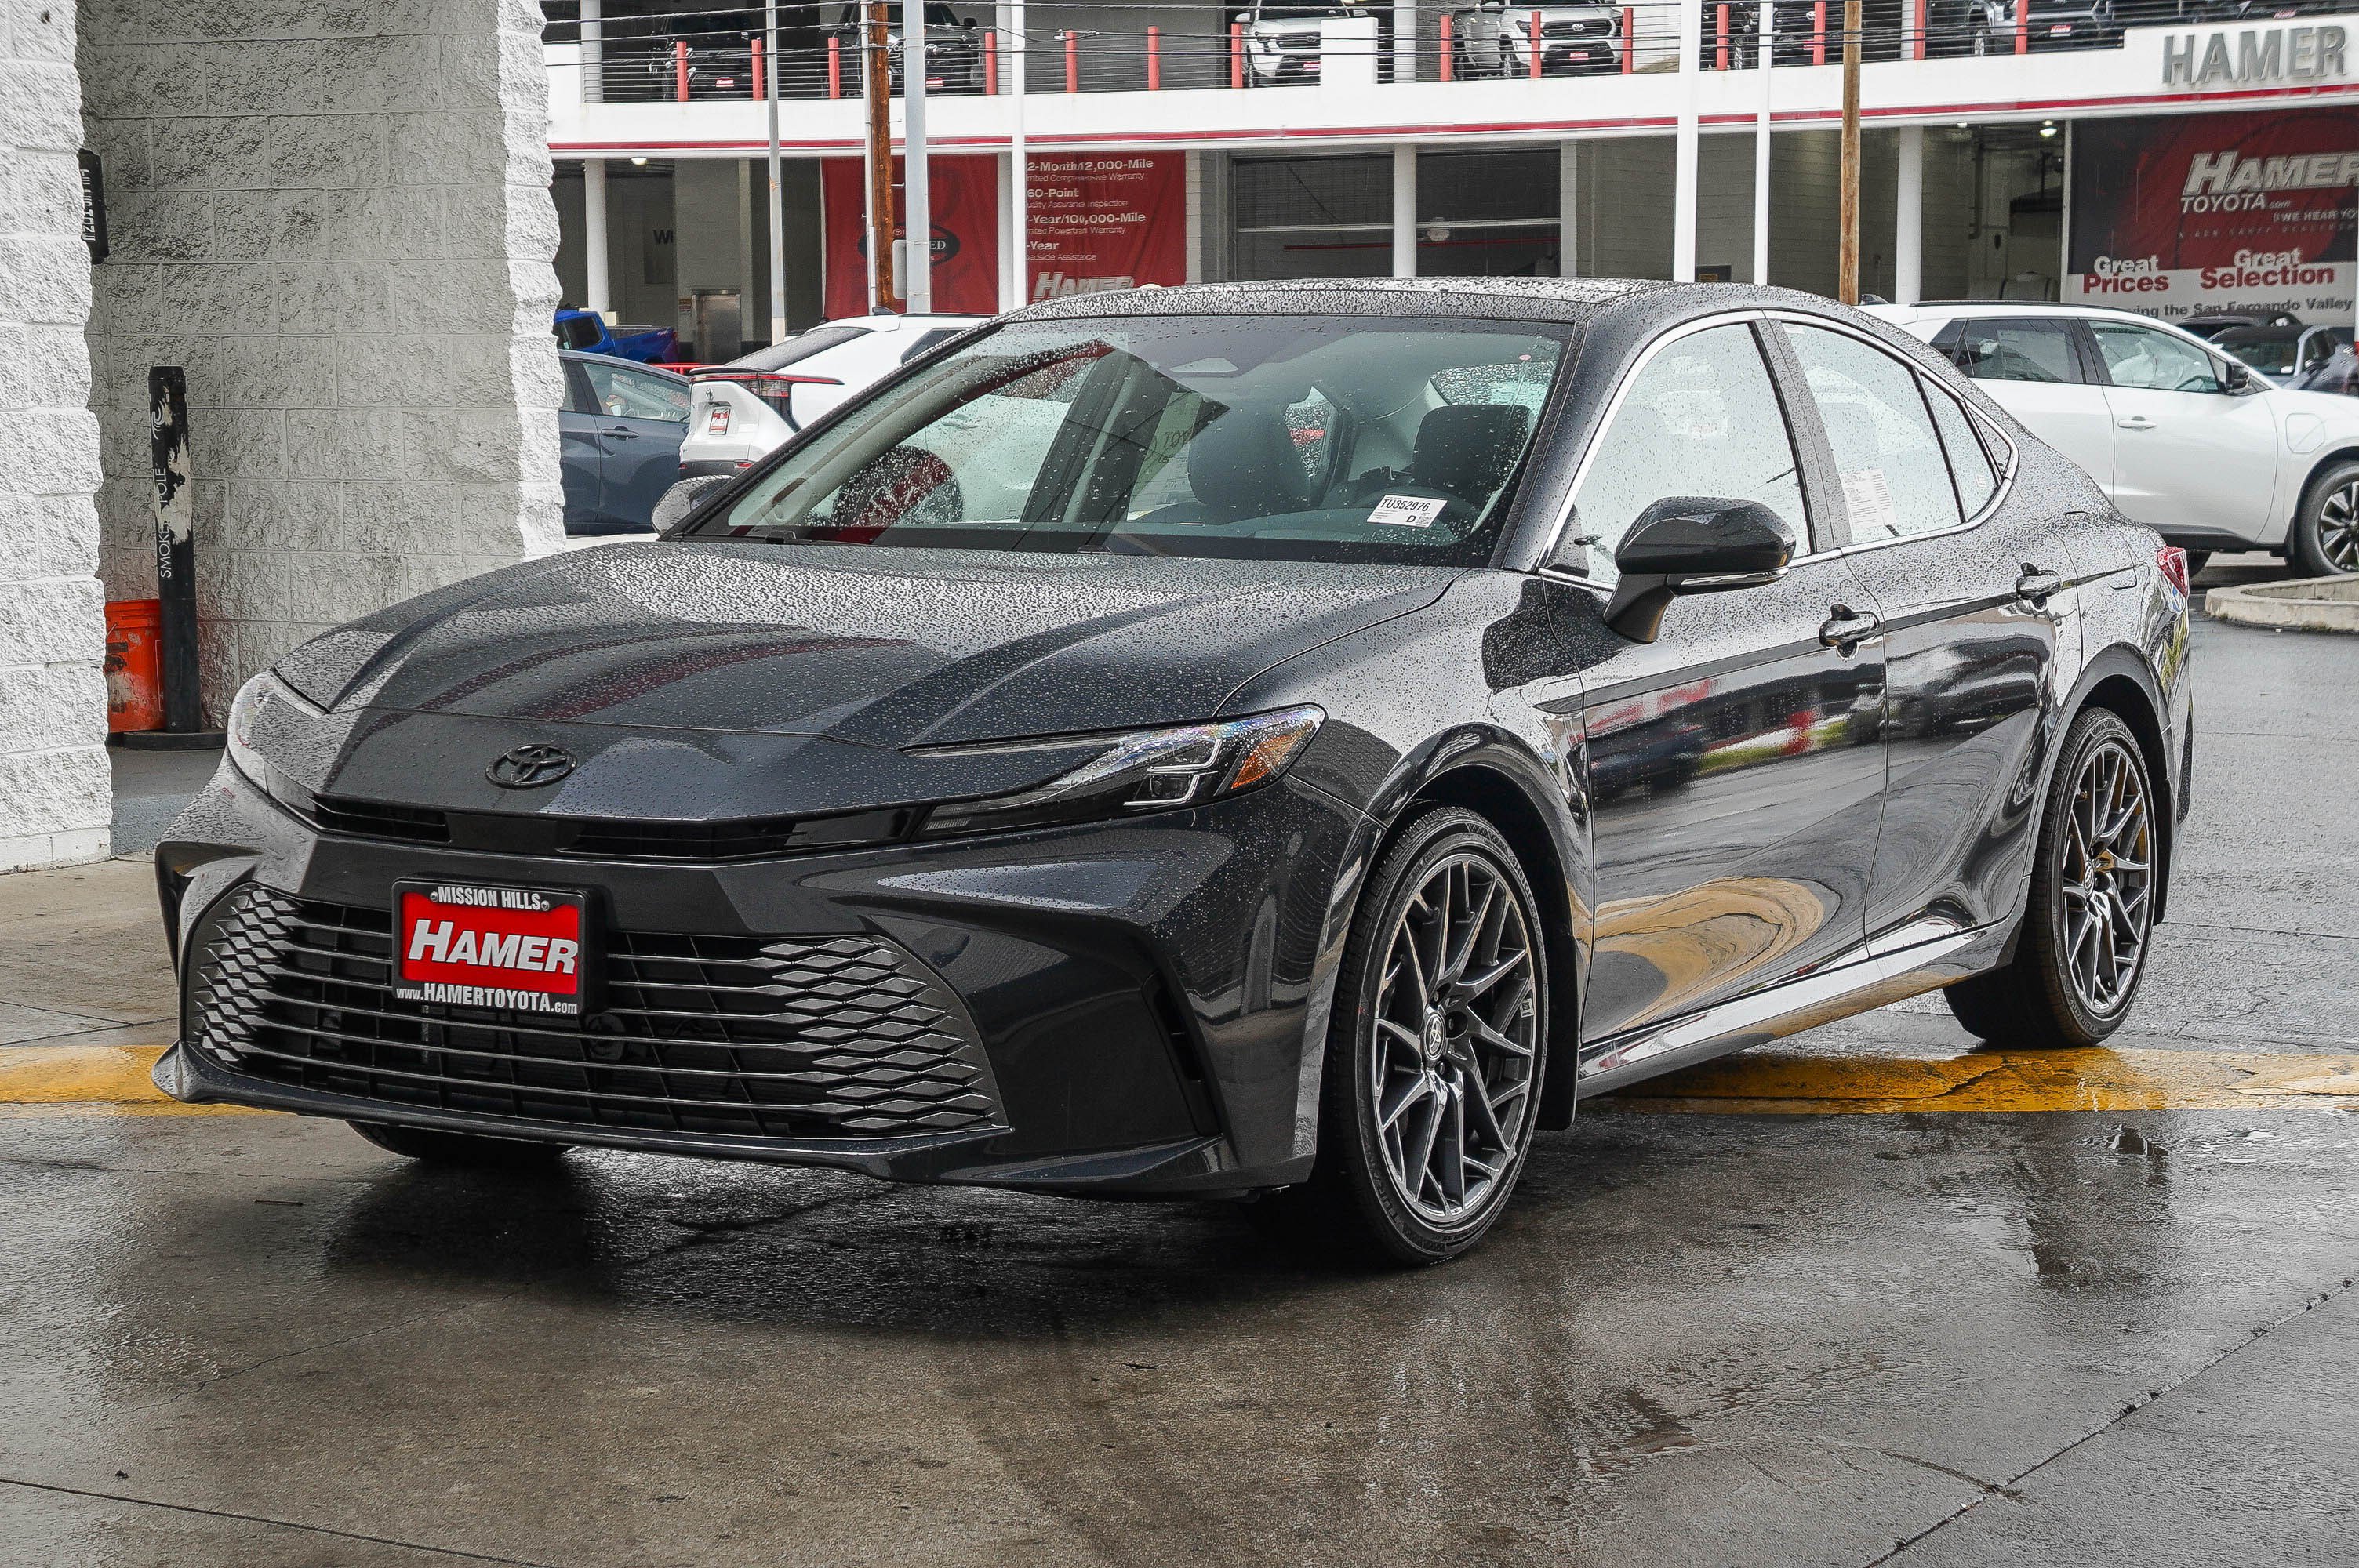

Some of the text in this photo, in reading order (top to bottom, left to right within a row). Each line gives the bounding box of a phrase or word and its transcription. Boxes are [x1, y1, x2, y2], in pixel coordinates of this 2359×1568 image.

[2163, 26, 2345, 83] HAMER
[2183, 151, 2357, 196] HAMER
[1027, 188, 1079, 198] 60-Point
[1088, 200, 1129, 209] Inspection
[2094, 247, 2302, 274] Great Great
[2083, 265, 2334, 294] Prices Selection
[2164, 304, 2188, 316] the
[2194, 303, 2223, 314] San
[2306, 297, 2353, 313] Valley
[1380, 499, 1431, 512] TU352976
[438, 887, 541, 911] MISSION HILLS
[408, 919, 579, 975] HAMER
[396, 982, 578, 1014] www.HAMERTOYOTA.com
